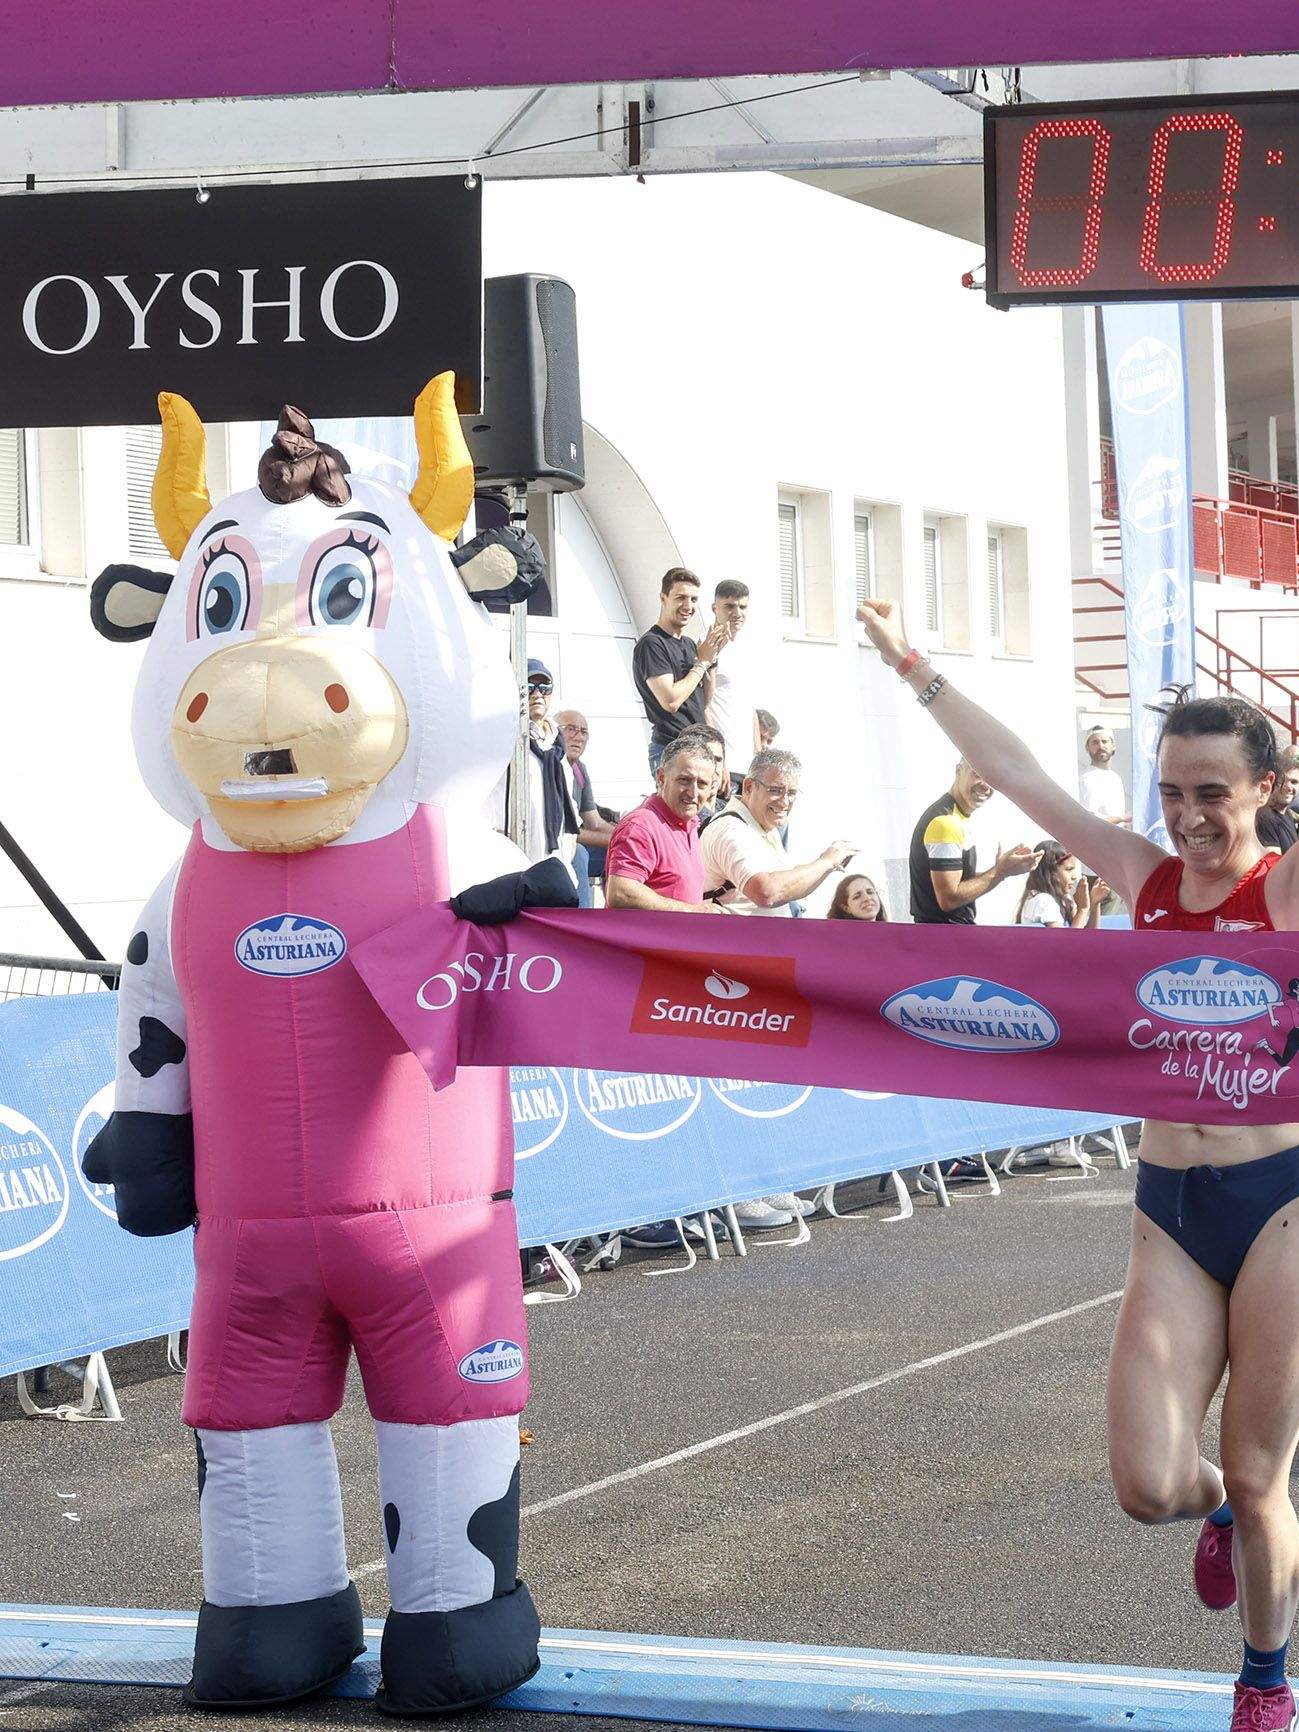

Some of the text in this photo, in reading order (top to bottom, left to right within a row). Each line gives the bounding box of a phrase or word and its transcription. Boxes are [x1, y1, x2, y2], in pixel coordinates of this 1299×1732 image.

[22, 259, 400, 355] OYSHO
[243, 938, 337, 962] ASTURIANA
[257, 931, 333, 943] CENTRAL LECHERA
[416, 952, 562, 1011] OSHO
[1148, 980, 1271, 1007] ASTURIANA
[1168, 978, 1265, 987] CENTRAL LECHERA
[650, 997, 795, 1032] Santander
[900, 1006, 1047, 1041] ASTURIANA
[917, 1005, 1037, 1019] CENTRAL LECHERA
[1128, 1018, 1244, 1055] Carrera
[510, 1067, 548, 1083] ECHERA
[1161, 1053, 1291, 1110] de la Mujer
